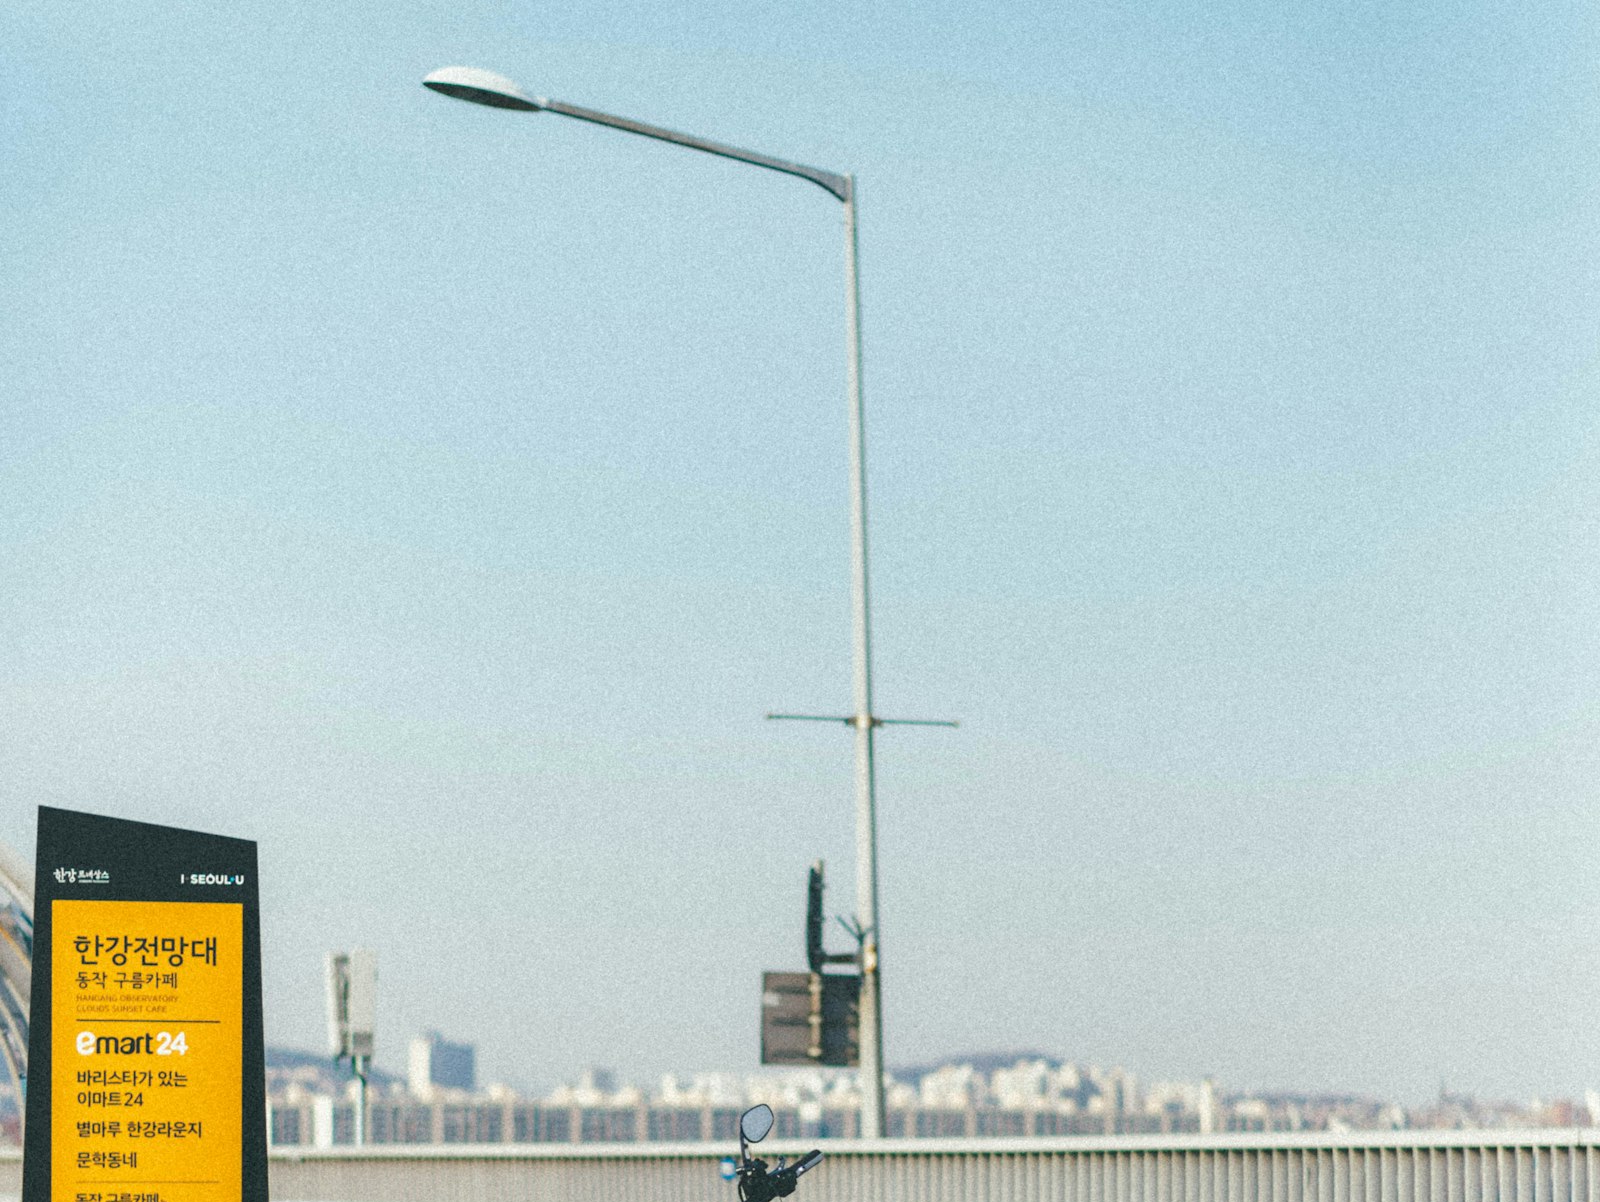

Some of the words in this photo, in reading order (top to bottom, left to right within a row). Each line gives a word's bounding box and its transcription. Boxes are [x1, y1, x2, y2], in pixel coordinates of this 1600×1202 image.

[53, 867, 77, 883] 한강
[73, 934, 217, 967] 한강전망대
[75, 972, 108, 989] 동작
[113, 972, 178, 989] 구름카페
[120, 994, 179, 1003] OBSERVATORY
[112, 1005, 143, 1013] SUNSET
[77, 1070, 153, 1087] 바리스타가
[158, 1071, 188, 1087] 있는
[76, 1121, 123, 1138] 별마루
[127, 1121, 203, 1138] 한강라운지
[76, 1151, 138, 1168] 문학동네
